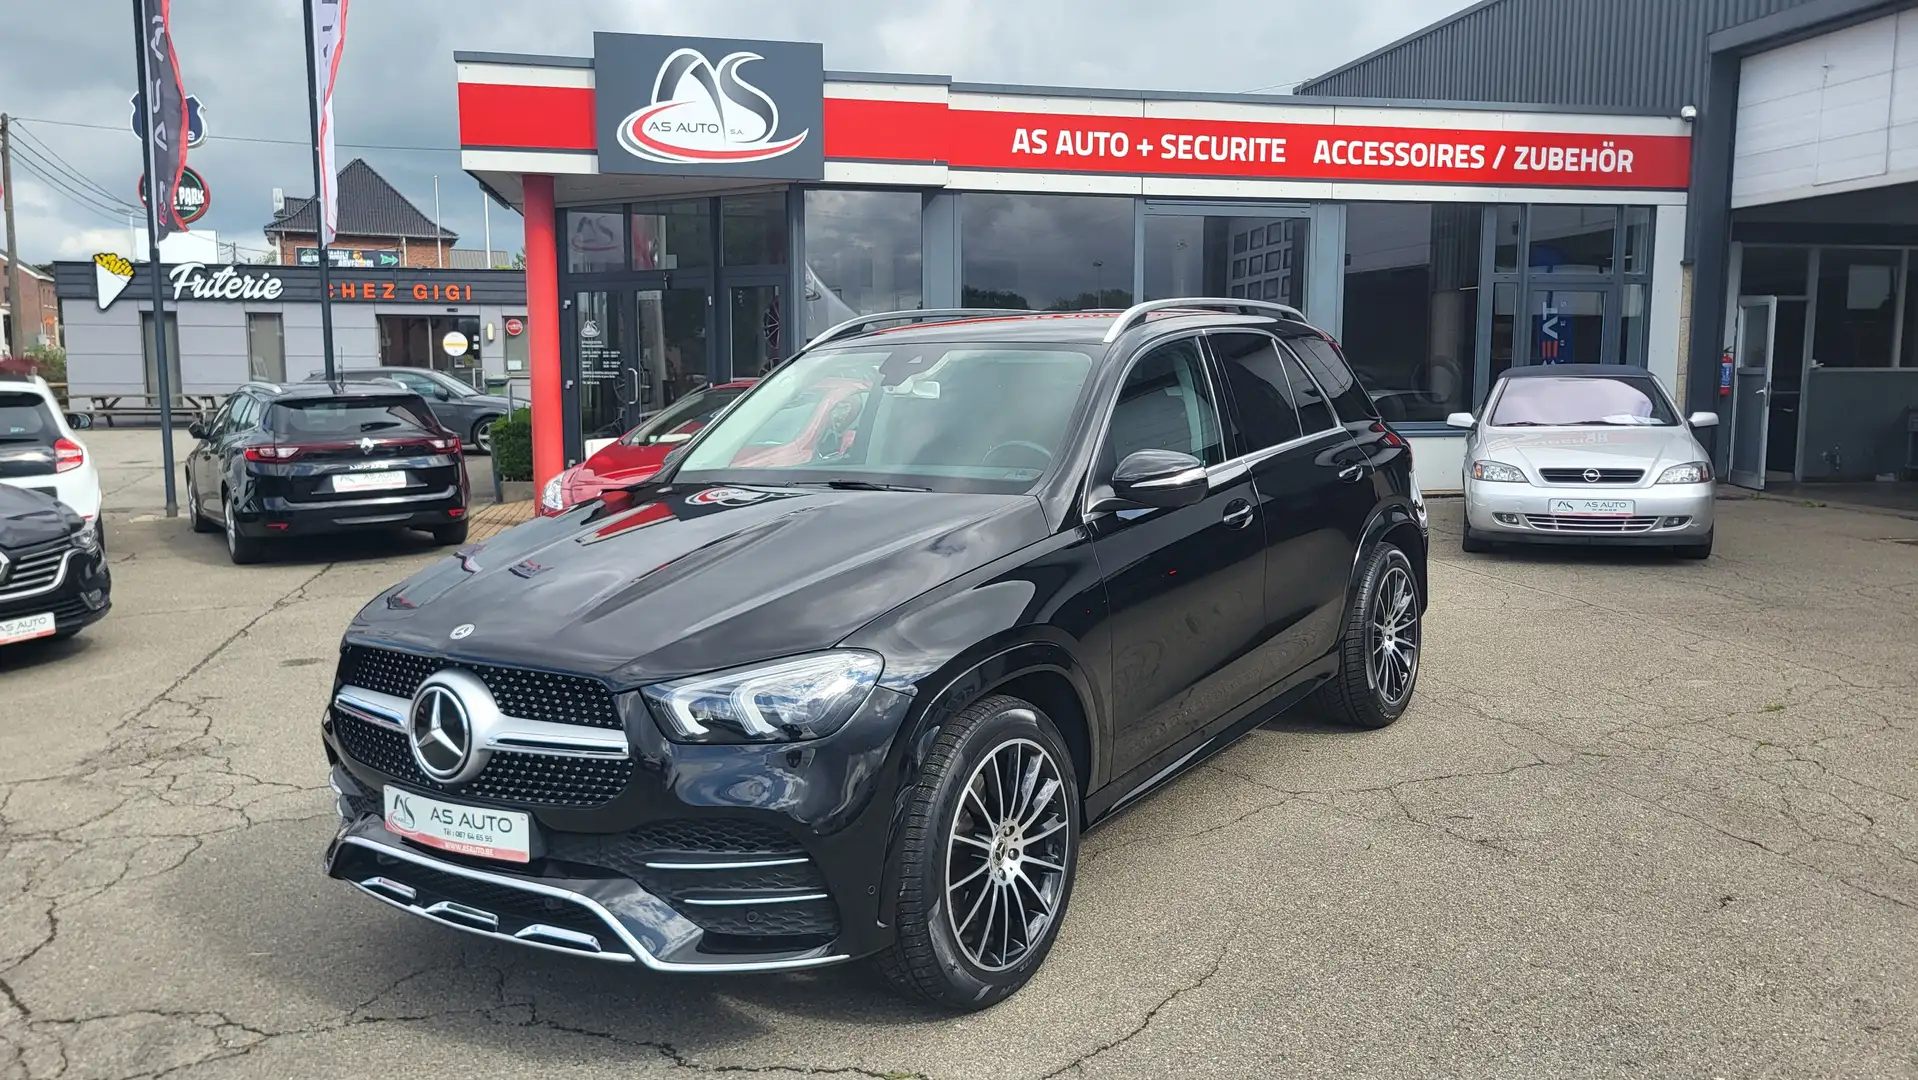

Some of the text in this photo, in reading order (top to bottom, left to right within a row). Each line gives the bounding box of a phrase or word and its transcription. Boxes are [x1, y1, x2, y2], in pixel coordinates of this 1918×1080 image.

[649, 122, 671, 132] AS
[676, 123, 719, 134] AUTO
[1011, 128, 1634, 173] AS AUTO + SECURITE ACCESSOIRES / ZUBEHÖR
[169, 261, 284, 300] Friterie
[329, 283, 472, 300] HEZ GIGI
[17, 617, 47, 628] AUTO
[430, 807, 453, 825] AS
[459, 812, 513, 833] AUTO
